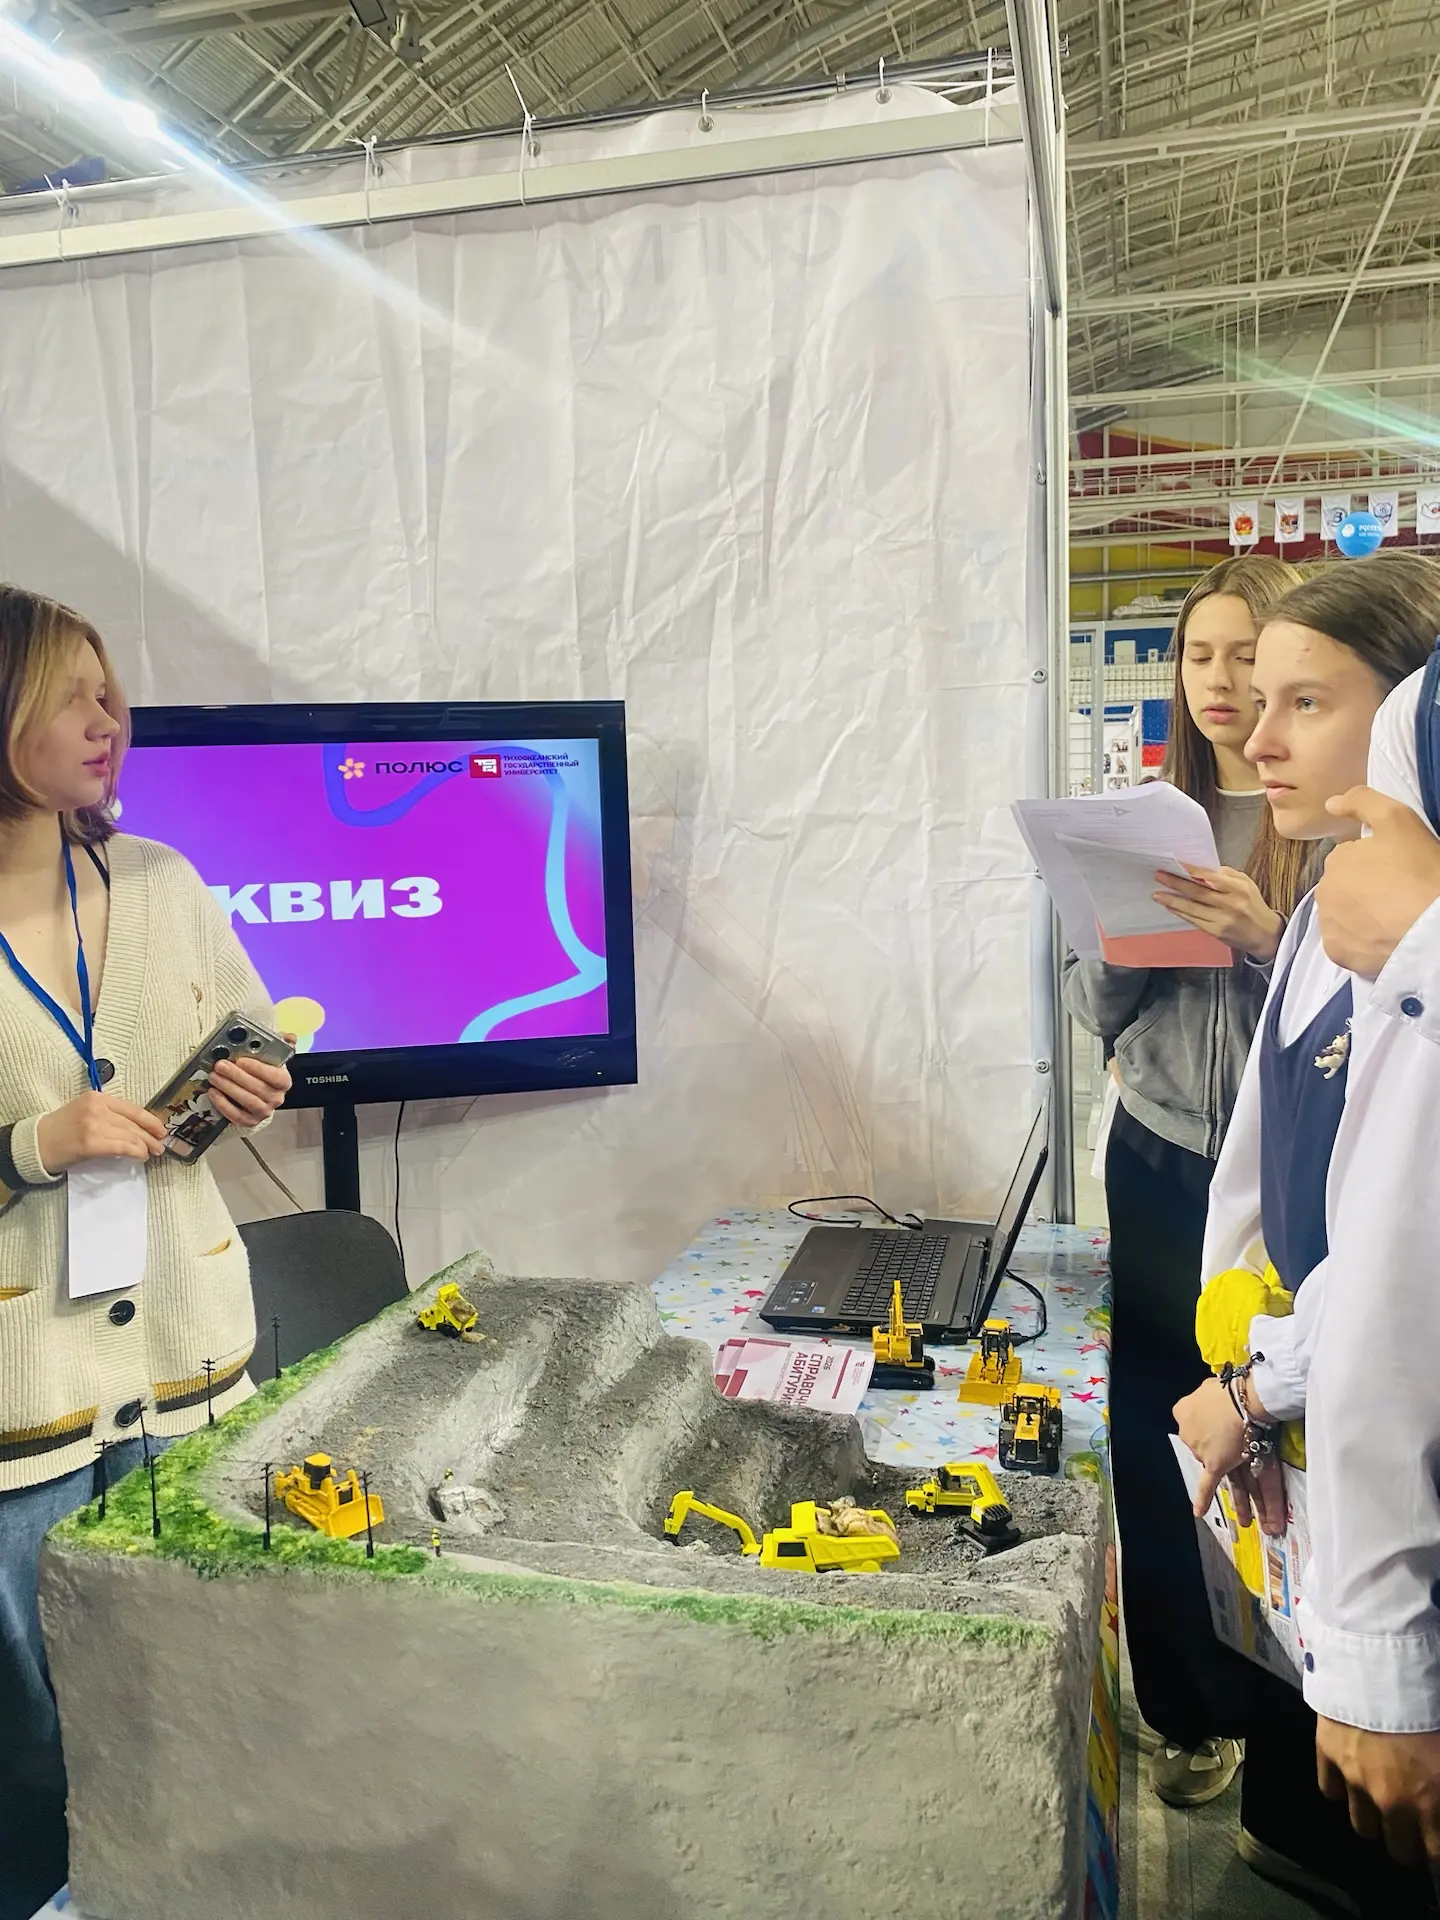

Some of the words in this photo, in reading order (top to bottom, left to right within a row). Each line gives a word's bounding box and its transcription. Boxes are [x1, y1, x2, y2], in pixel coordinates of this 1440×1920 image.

[503, 752, 569, 762] ТИХООКЕАНСКИЙ
[375, 760, 464, 775] ПОЛЮС
[503, 760, 580, 769] ГОСУДАРСТВЕННЫЙ
[503, 768, 558, 776] УНИВЕРСИТЕТ
[207, 876, 444, 924] КВИЗ
[305, 1074, 350, 1085] TOSHIBA
[823, 1355, 835, 1371] 2026
